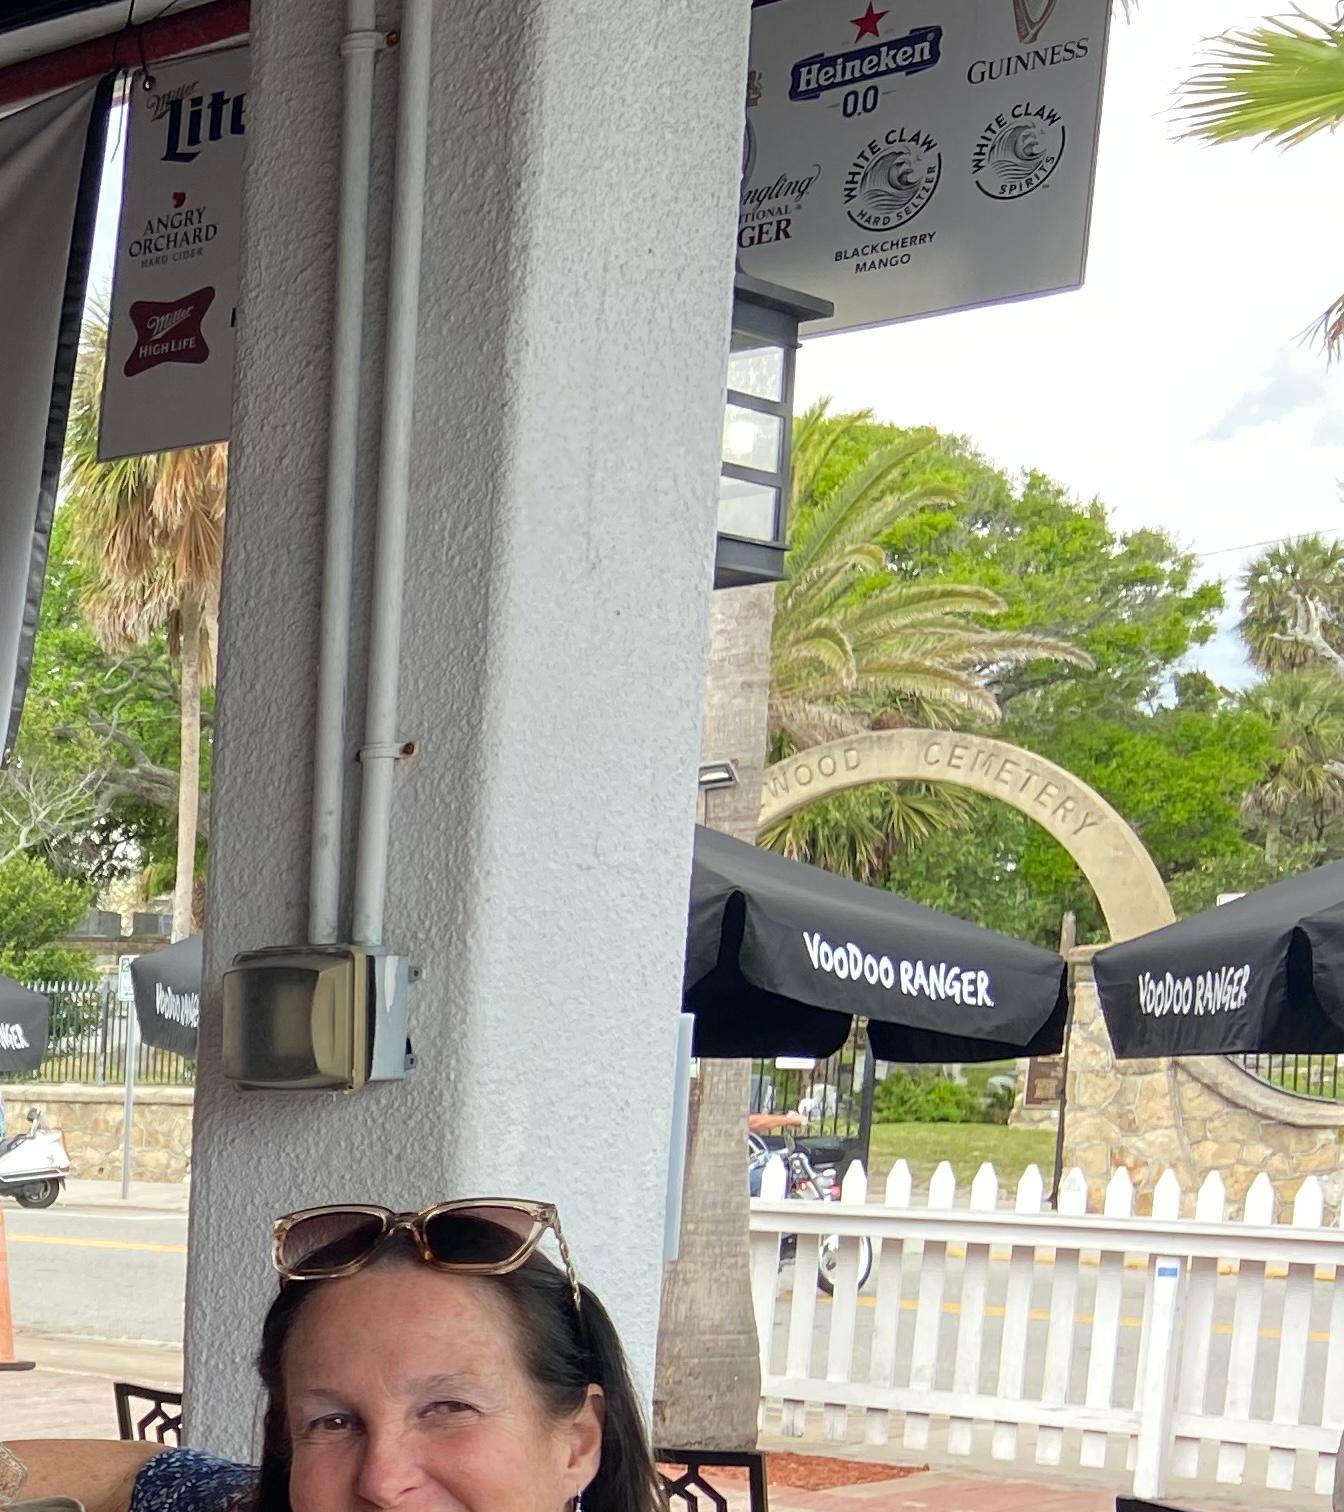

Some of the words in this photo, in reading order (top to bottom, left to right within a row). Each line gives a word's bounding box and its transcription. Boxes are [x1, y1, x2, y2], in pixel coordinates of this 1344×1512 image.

[798, 41, 932, 92] Heineken
[967, 38, 1089, 85] GUINNESS
[842, 86, 879, 118] 0.0
[972, 113, 1008, 175] WHITE
[1010, 101, 1062, 127] CLAW
[843, 139, 882, 204] WHITE
[884, 127, 938, 153] CLAW
[998, 154, 1056, 195] SPIRITS
[743, 163, 822, 210] ngling
[857, 209, 891, 226] HARD
[896, 165, 937, 221] SELTZER
[144, 206, 207, 236] ANGRY
[742, 204, 792, 223] TIONAL
[128, 223, 218, 258] ORCHARD
[738, 218, 792, 248] GER
[834, 232, 937, 262] BLACKCHERRY
[141, 253, 169, 269] HARD
[172, 247, 204, 262] CIDER
[855, 253, 912, 274] MANGO
[147, 305, 194, 341] Miller
[139, 340, 169, 358] HIGH
[171, 336, 197, 353] LIFE
[762, 748, 862, 799] WOOD
[923, 742, 1099, 837] CEMETERY
[802, 931, 894, 988] VOODOO
[1137, 972, 1192, 1018] VOODOO
[1194, 964, 1251, 1016] RANGER
